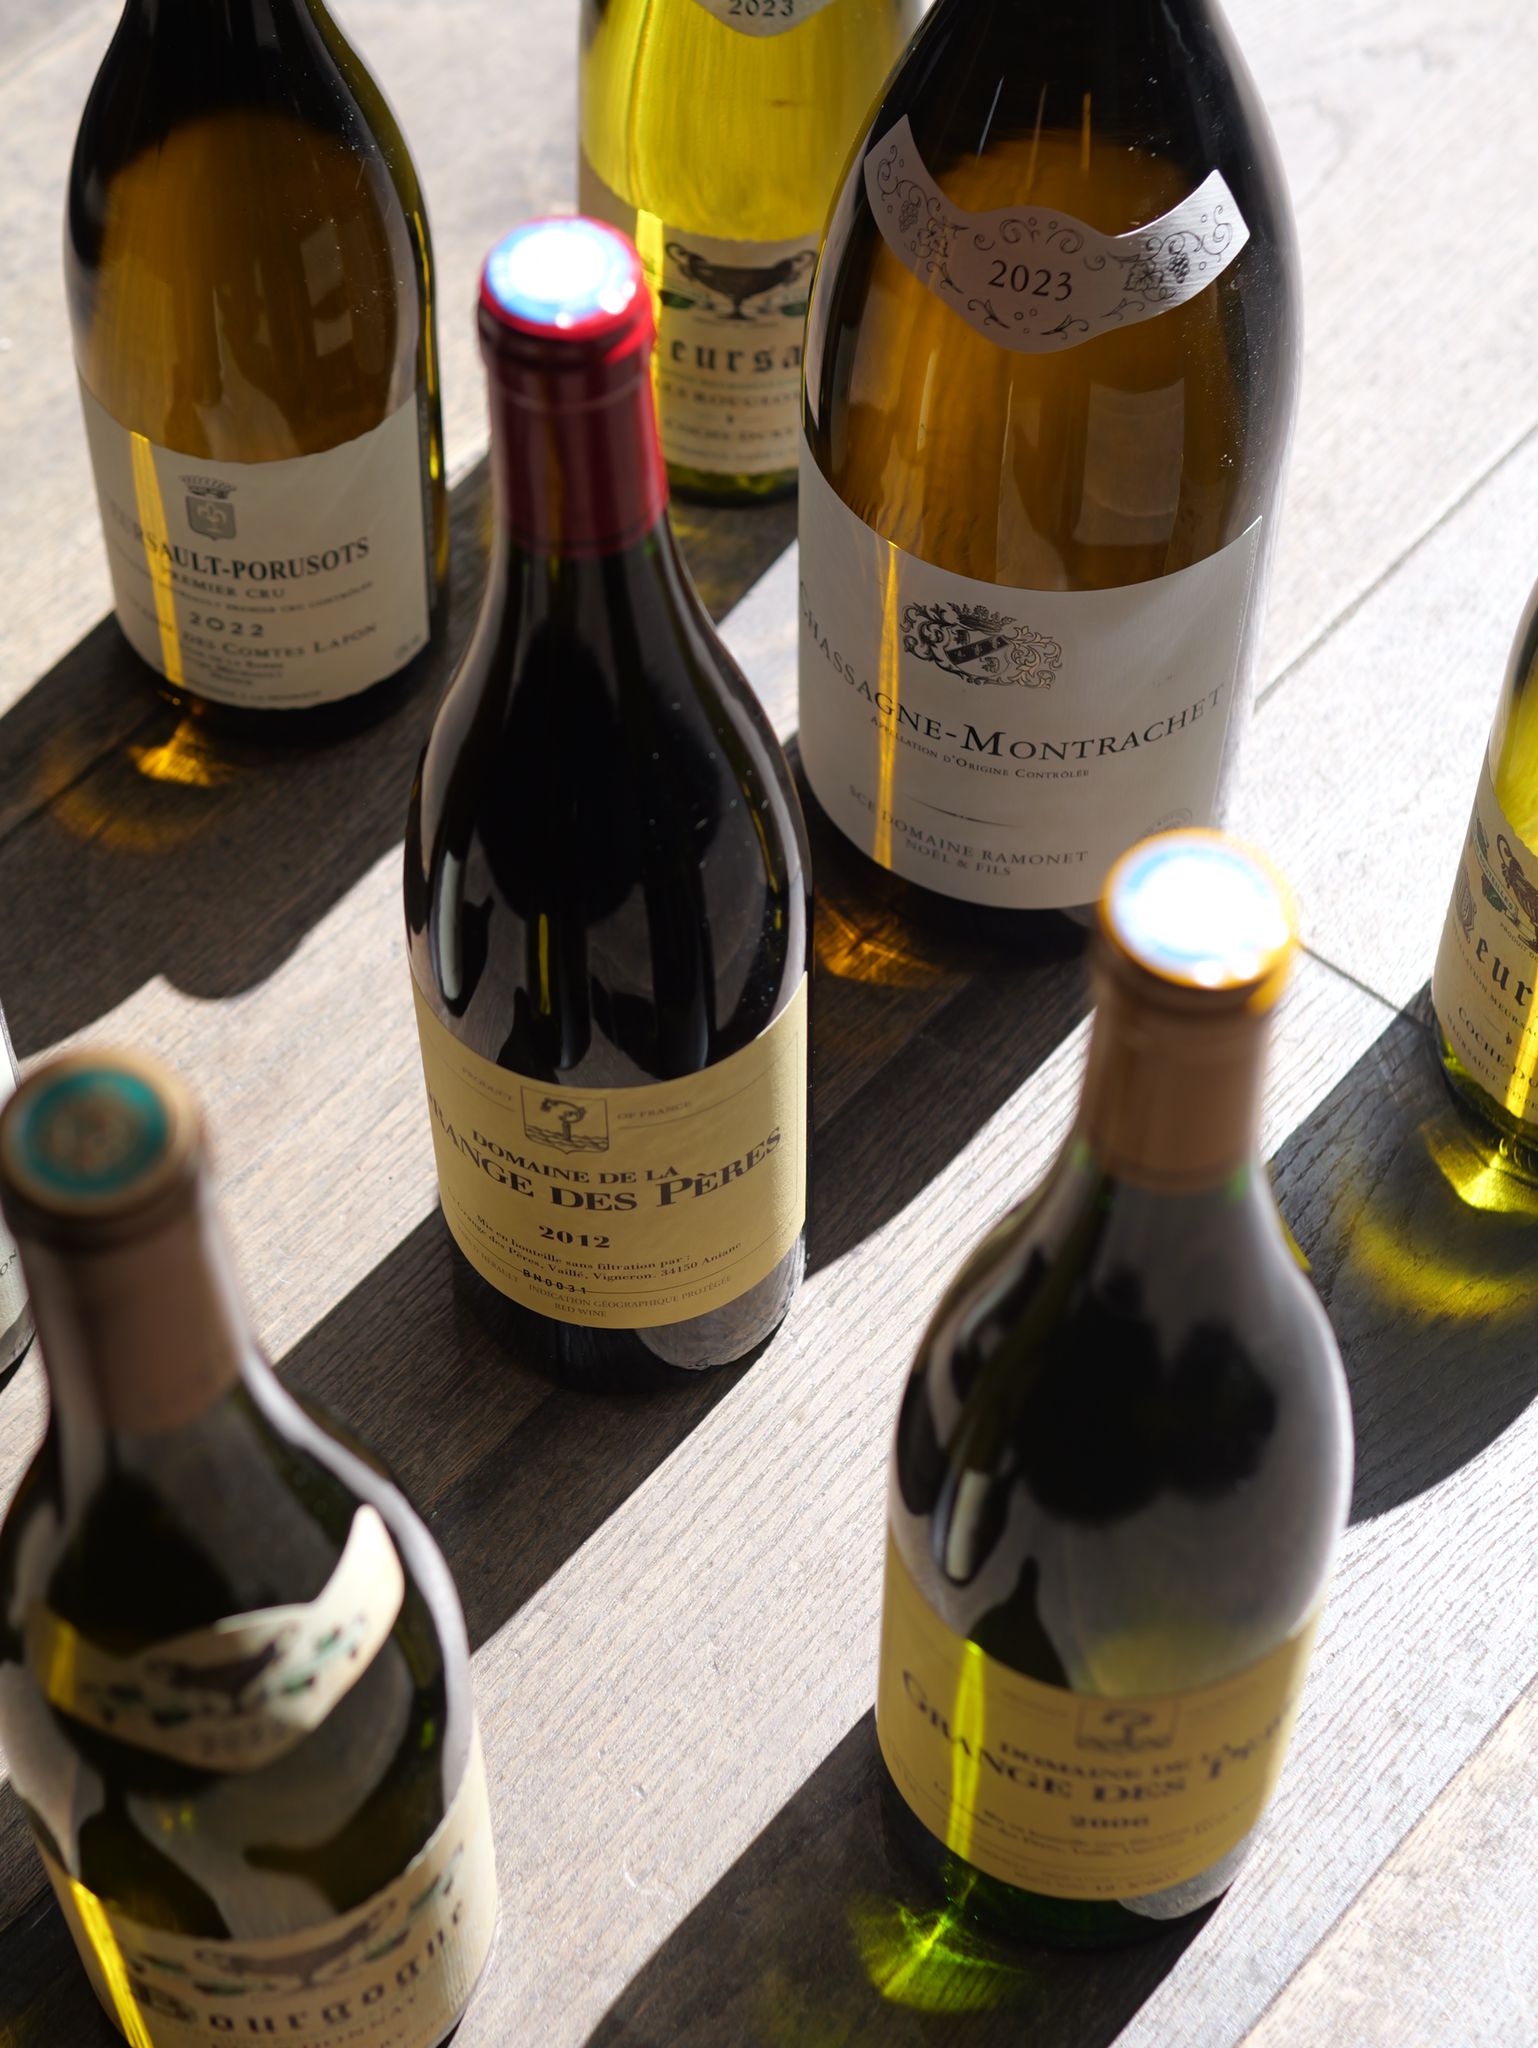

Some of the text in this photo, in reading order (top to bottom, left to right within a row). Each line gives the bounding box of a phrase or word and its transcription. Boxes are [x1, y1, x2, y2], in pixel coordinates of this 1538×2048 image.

[728, 0, 794, 17] 2023
[989, 259, 1073, 301] 2023
[671, 338, 802, 373] eursa
[245, 588, 286, 599] CRU
[189, 611, 264, 637] 2022
[880, 808, 974, 859] DOMAINE
[981, 846, 1089, 867] RAMONET
[974, 862, 1011, 878] FILS
[639, 1101, 693, 1119] FRANCE
[472, 1127, 680, 1185] DOMAINE DE LA
[551, 1186, 638, 1212] DES
[656, 1126, 782, 1208] PÈRES
[538, 1224, 611, 1249] 2012
[511, 1238, 563, 1263] bouteille
[565, 1260, 593, 1270] sans
[597, 1257, 656, 1271] filtration
[554, 1302, 608, 1318] RED WINE
